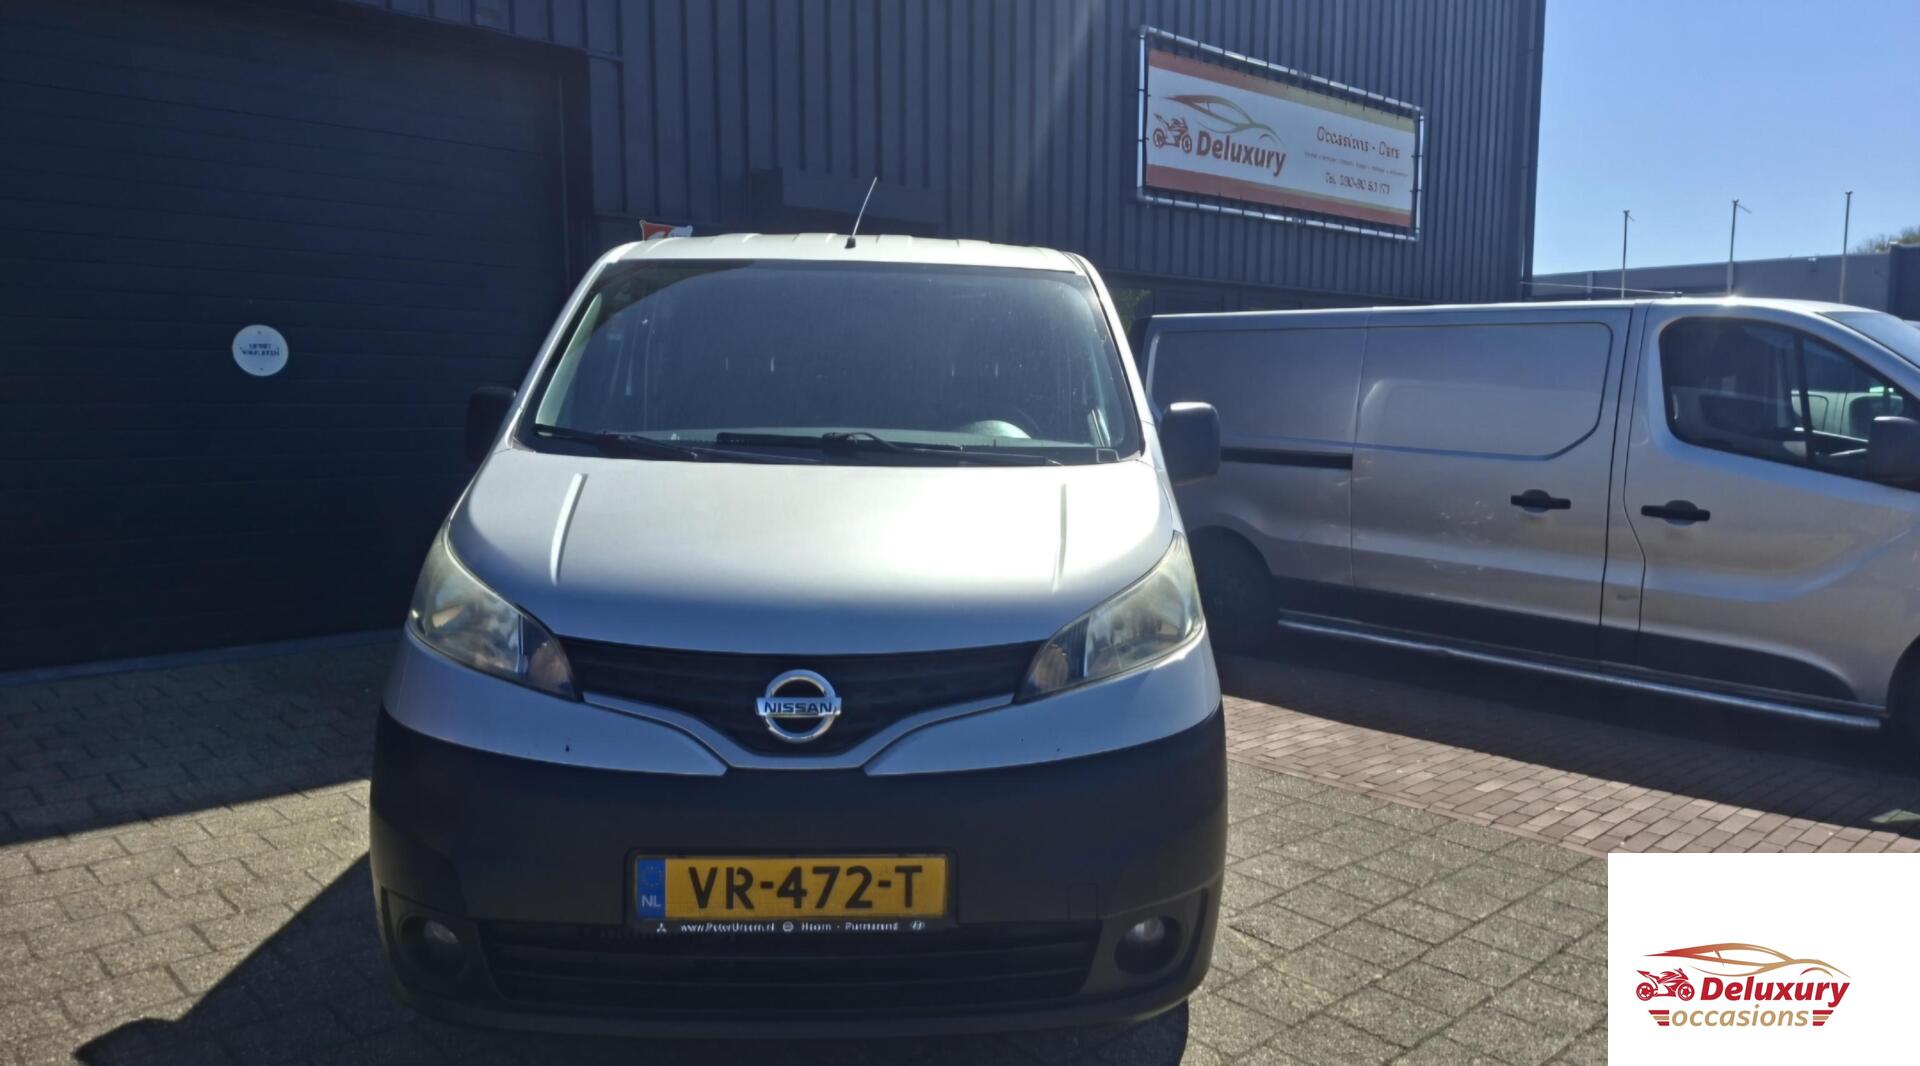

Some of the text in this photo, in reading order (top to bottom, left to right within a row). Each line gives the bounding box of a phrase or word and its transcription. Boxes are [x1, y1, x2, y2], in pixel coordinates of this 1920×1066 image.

[1196, 129, 1287, 177] Deluxury
[764, 702, 832, 713] NISSAN
[641, 894, 662, 908] NL
[688, 864, 923, 910] VR-472-T
